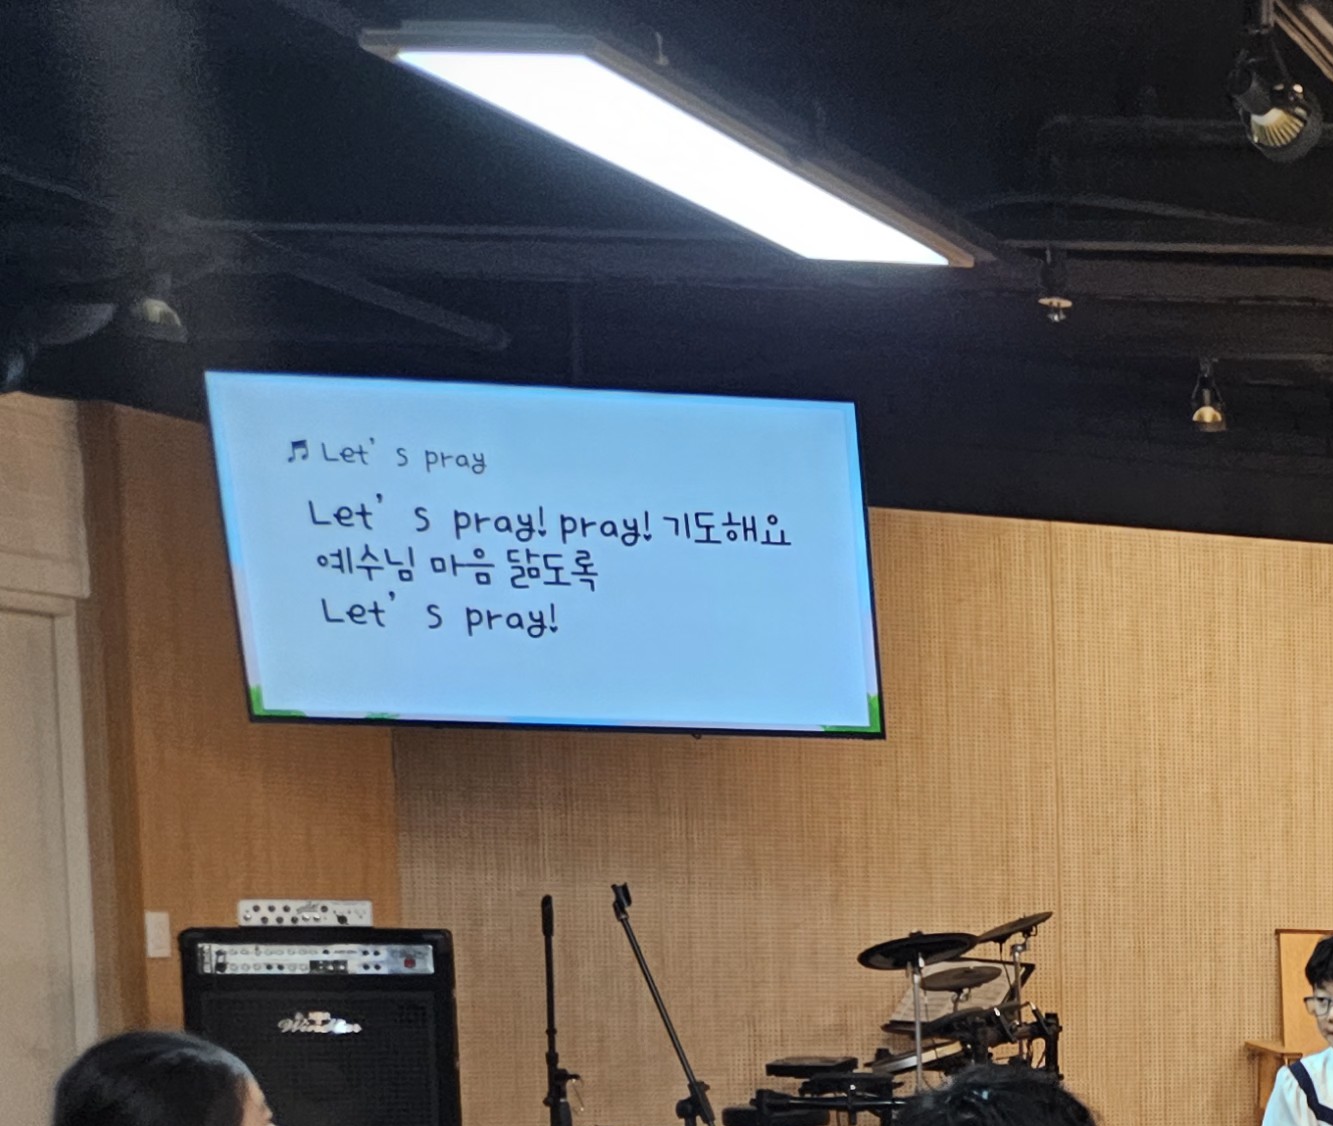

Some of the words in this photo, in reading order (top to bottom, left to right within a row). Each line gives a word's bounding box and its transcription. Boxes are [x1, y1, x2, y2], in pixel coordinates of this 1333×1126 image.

[424, 449, 487, 475] pray
[453, 505, 547, 543] pray!
[559, 510, 653, 547] pray!
[663, 511, 792, 546] 기도해요
[316, 543, 415, 582] 예수님
[429, 547, 495, 586] 마음
[506, 548, 599, 592] 닮도록
[465, 603, 559, 639] pray!
